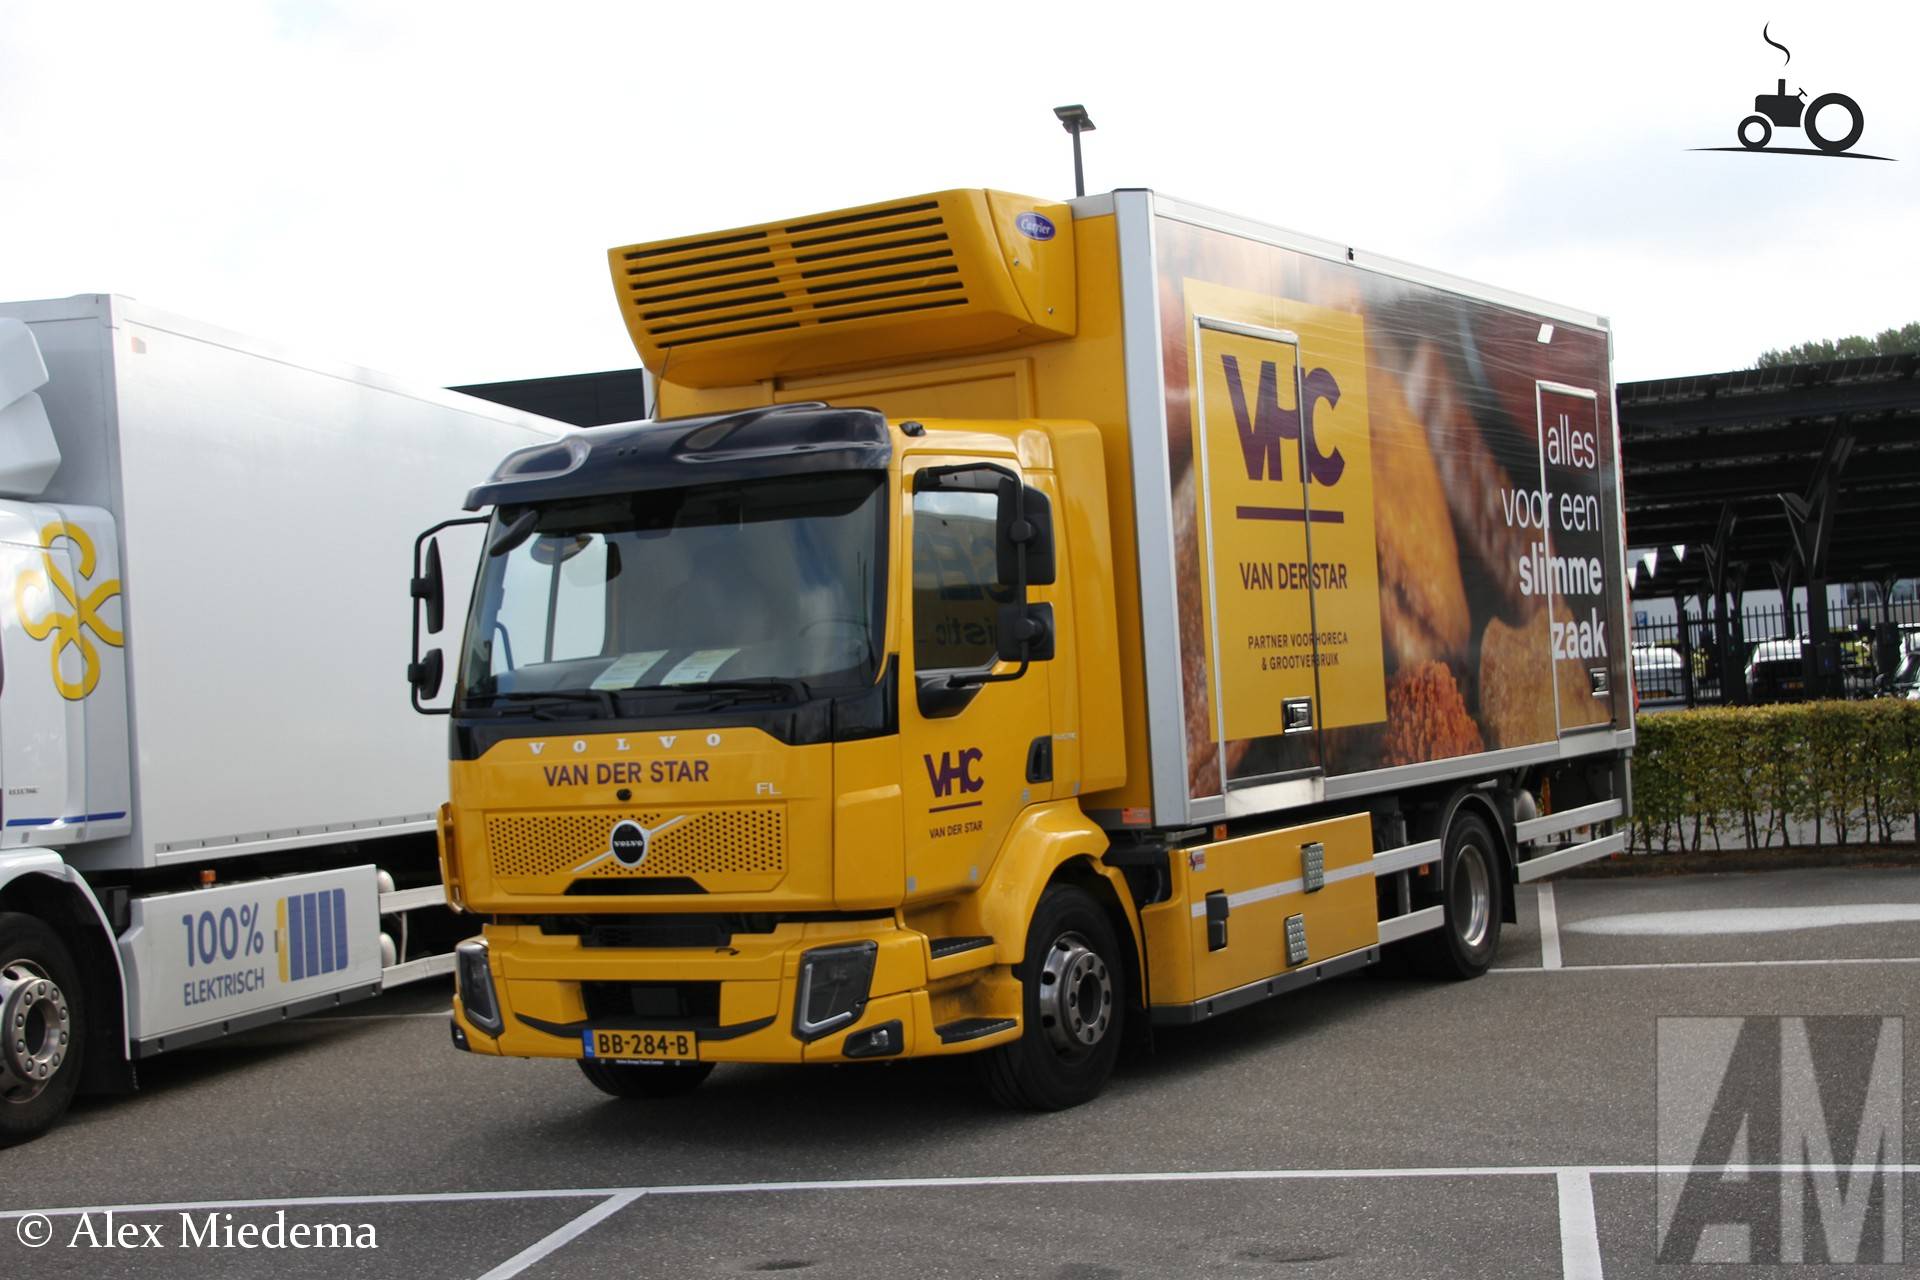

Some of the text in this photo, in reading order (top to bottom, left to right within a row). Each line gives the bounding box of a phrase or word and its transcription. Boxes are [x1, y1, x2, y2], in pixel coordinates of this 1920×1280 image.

[1221, 354, 1345, 487] VHC
[1548, 414, 1595, 469] alles
[1501, 488, 1599, 532] voor een
[1240, 562, 1348, 590] VAN DER STAR
[1519, 542, 1602, 595] slimme
[1248, 634, 1288, 649] PARTNER
[1551, 607, 1607, 659] zaak
[1262, 656, 1268, 671] &
[529, 733, 722, 755] VOLVO
[544, 760, 709, 787] VAN DER STAR
[923, 747, 984, 798] VHC
[756, 782, 782, 795] FL
[929, 820, 984, 839] VAN DER STAR
[613, 840, 644, 848] VOLVO
[182, 902, 264, 968] 100%
[184, 966, 265, 1007] ELEKTRISCH
[598, 1033, 690, 1056] BB-284-B
